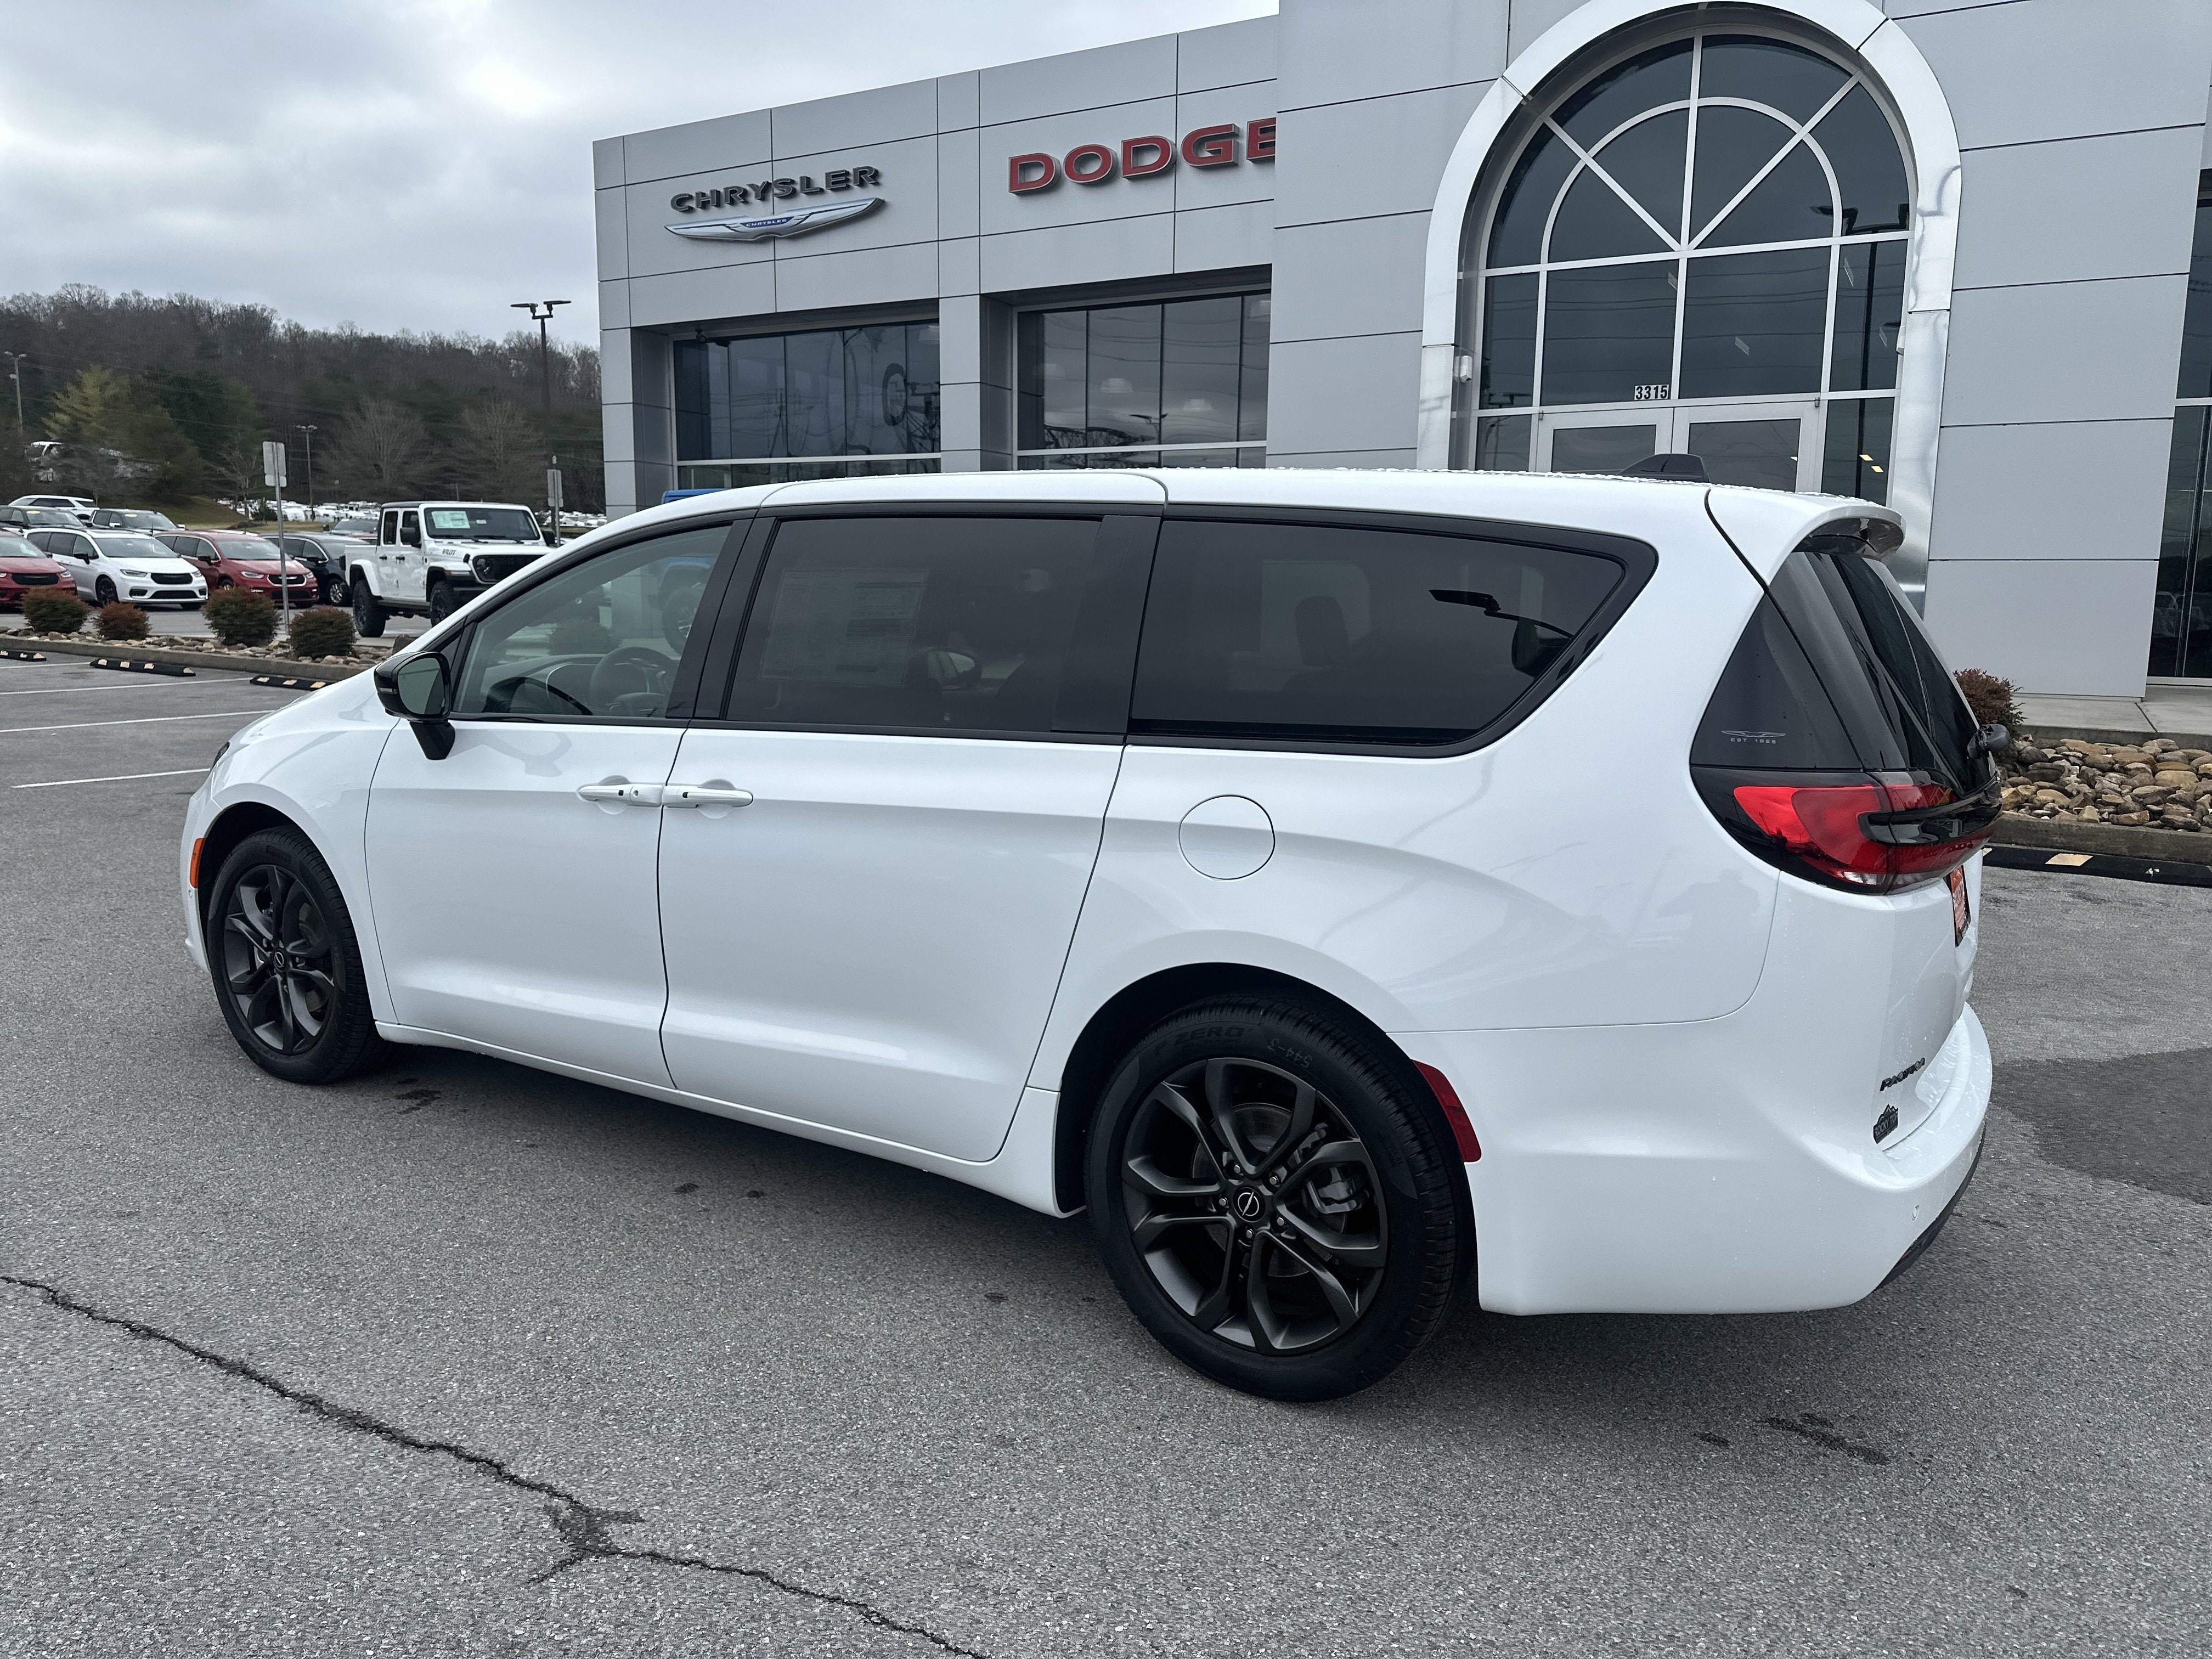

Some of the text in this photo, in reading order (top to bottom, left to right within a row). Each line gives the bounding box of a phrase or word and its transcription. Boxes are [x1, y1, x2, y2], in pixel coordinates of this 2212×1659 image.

[1008, 117, 1276, 194] DODGE
[670, 166, 879, 212] CHRYSLER
[1635, 385, 1668, 400] 3315
[1173, 1026, 1245, 1046] ZERO
[1267, 1037, 1313, 1069] 544-3
